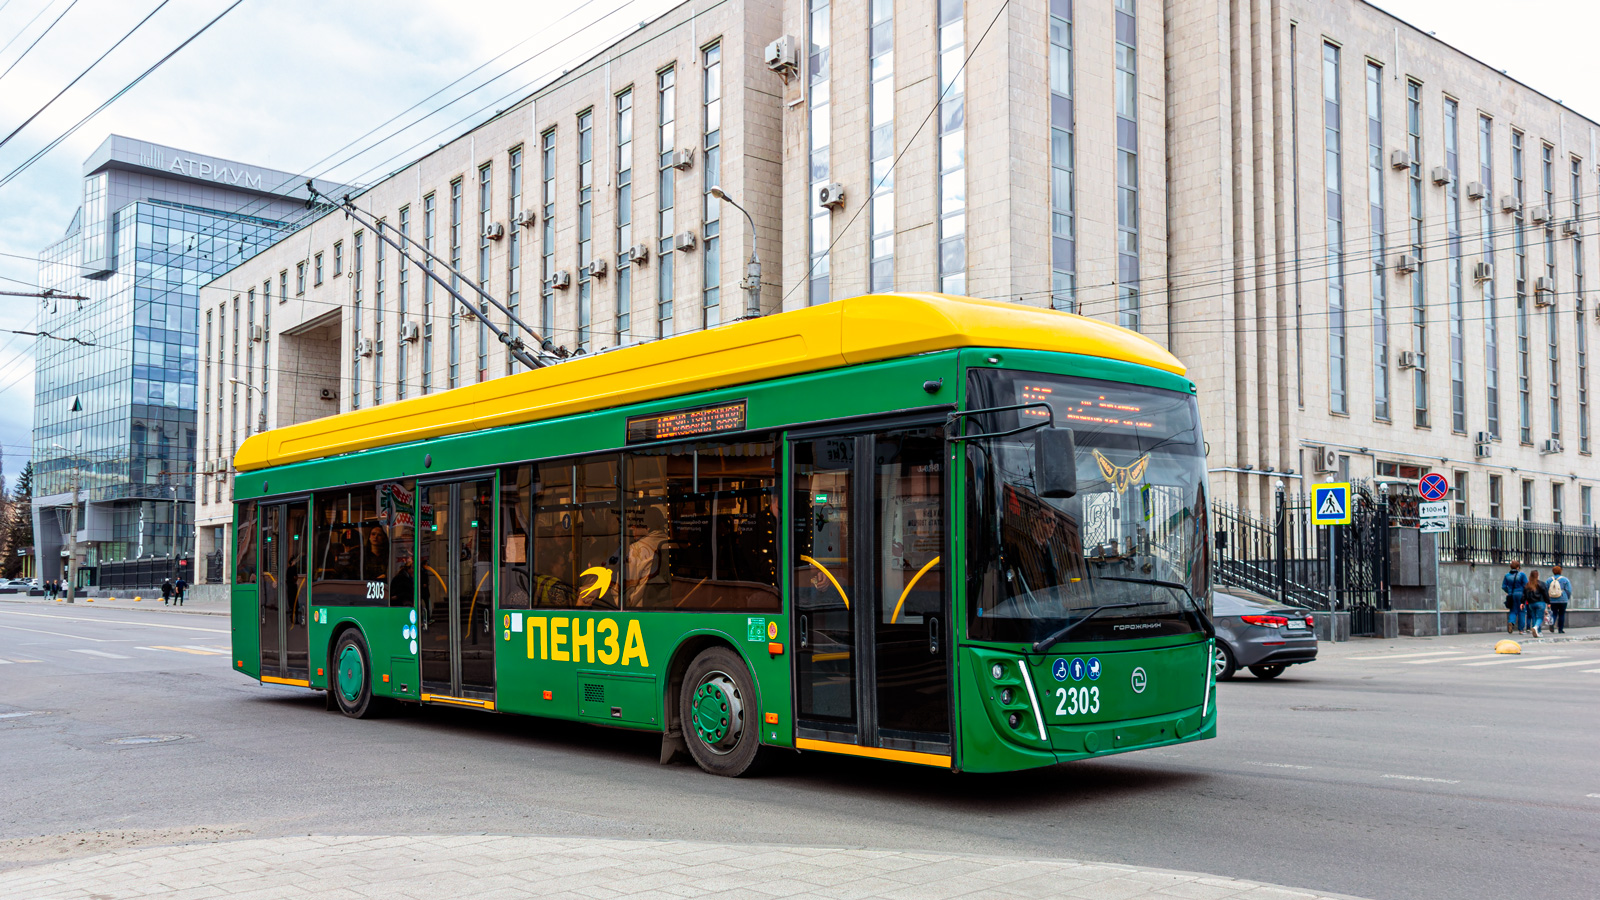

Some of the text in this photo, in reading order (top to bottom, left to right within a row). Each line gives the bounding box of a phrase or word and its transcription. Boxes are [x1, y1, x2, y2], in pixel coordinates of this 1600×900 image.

[169, 156, 262, 189] АТРИУМ
[366, 581, 385, 599] 2303
[527, 616, 649, 667] ПЕНЗА
[1113, 622, 1162, 631] ГОРОЖАНИН
[1055, 686, 1100, 716] 2303
